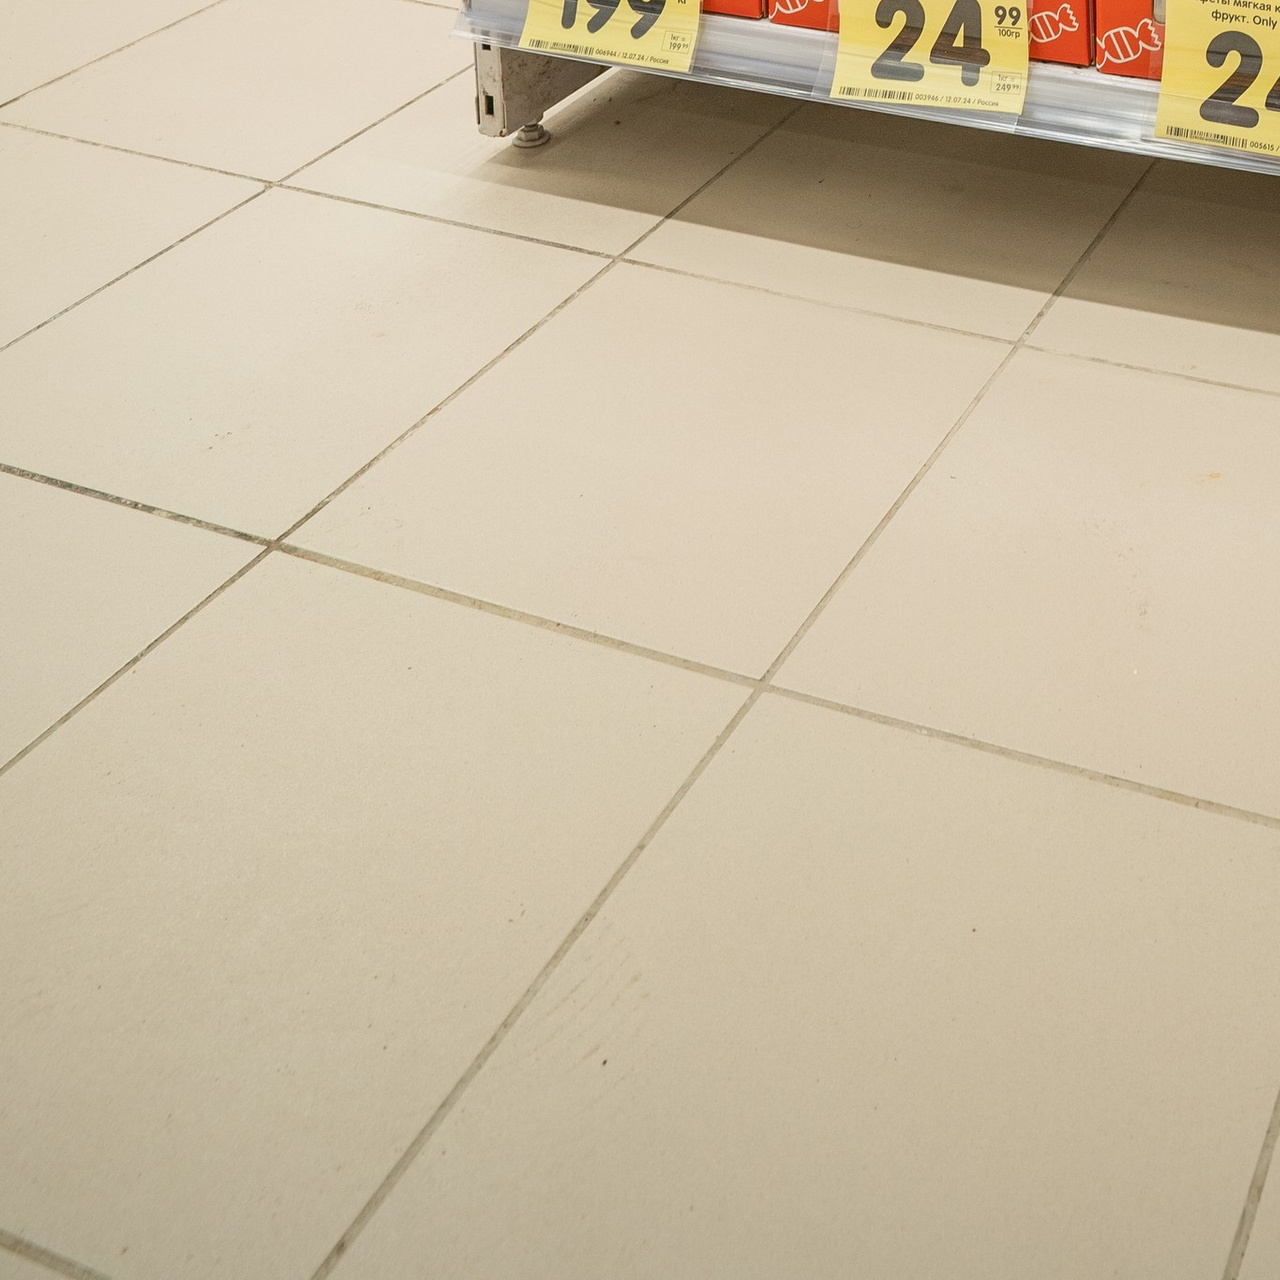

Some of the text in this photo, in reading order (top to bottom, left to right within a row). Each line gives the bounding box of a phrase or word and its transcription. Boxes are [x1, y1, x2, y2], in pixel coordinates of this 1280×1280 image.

[1233, 0, 1272, 12] мягкая
[1212, 10, 1249, 24] фрукт.
[1253, 16, 1278, 30] Only
